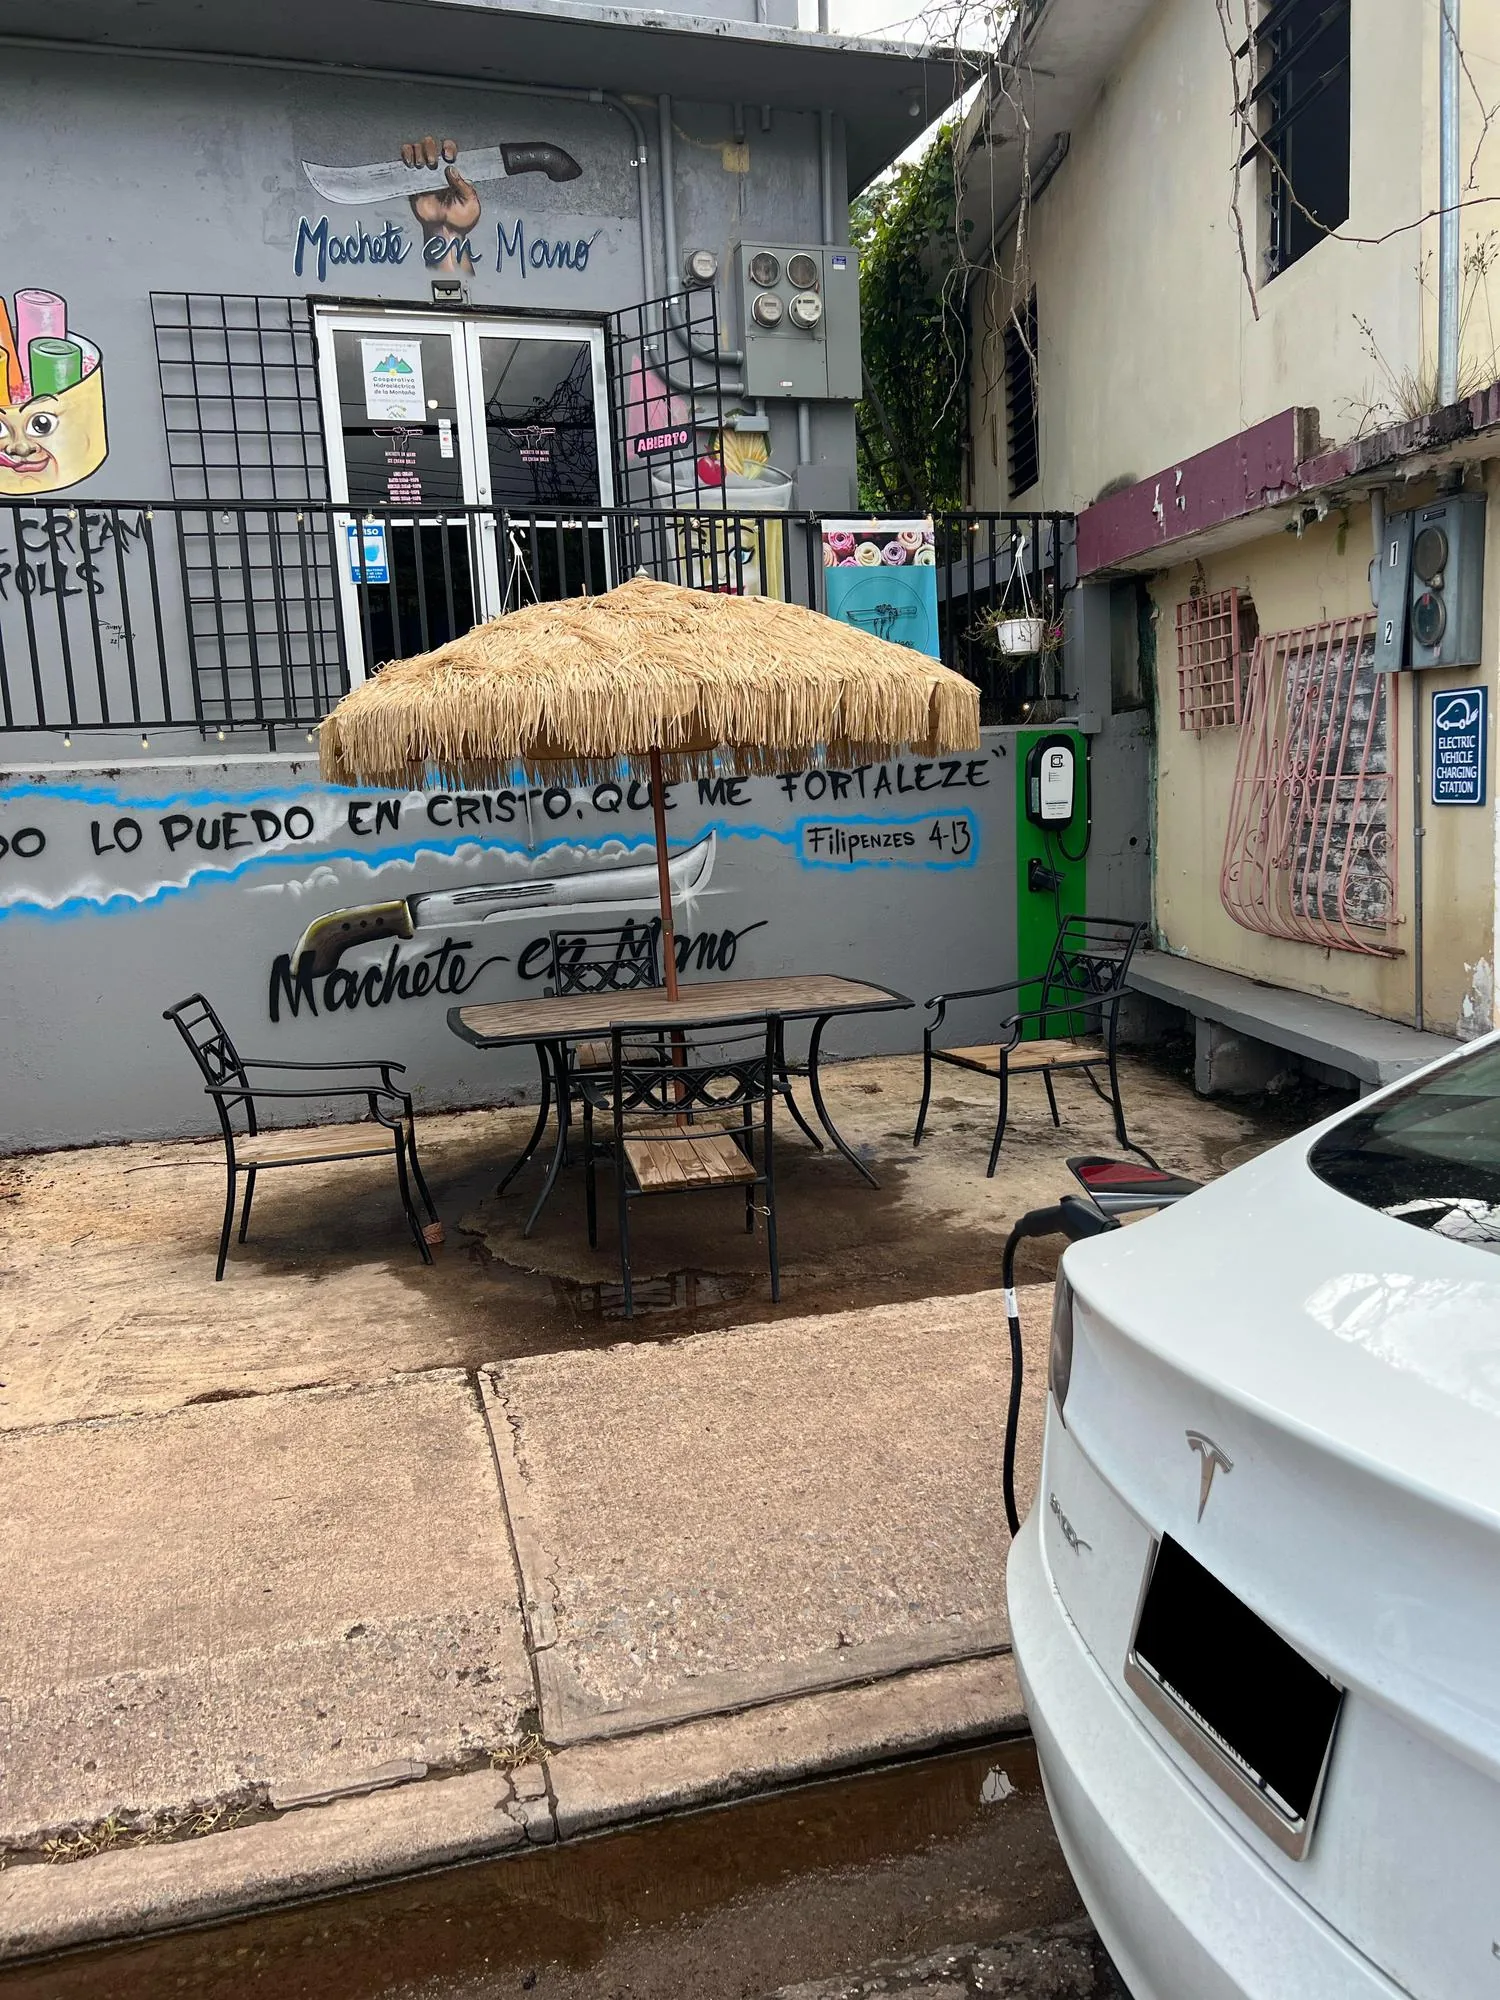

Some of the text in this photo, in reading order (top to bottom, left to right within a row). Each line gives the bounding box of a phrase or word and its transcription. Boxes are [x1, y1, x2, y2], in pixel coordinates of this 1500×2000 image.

[294, 215, 602, 282] Machete en Mano
[638, 430, 688, 452] ABIERTO
[17, 511, 151, 554] CREAM
[352, 528, 378, 536] AISO
[1392, 542, 1397, 565] 1
[1385, 621, 1393, 644] 2
[1438, 735, 1476, 749] ELECTRIC
[1440, 751, 1474, 764] VEHICLE
[1436, 766, 1478, 779] CHARGING
[1439, 781, 1474, 793] STATION
[91, 817, 142, 856] LO
[159, 805, 314, 852] PUEDO
[348, 800, 401, 836] EN
[427, 787, 583, 828] CRISTO,
[592, 779, 680, 813] QUE
[698, 776, 752, 806] ME
[929, 820, 971, 854] 4-13
[270, 937, 510, 1022] Machete
